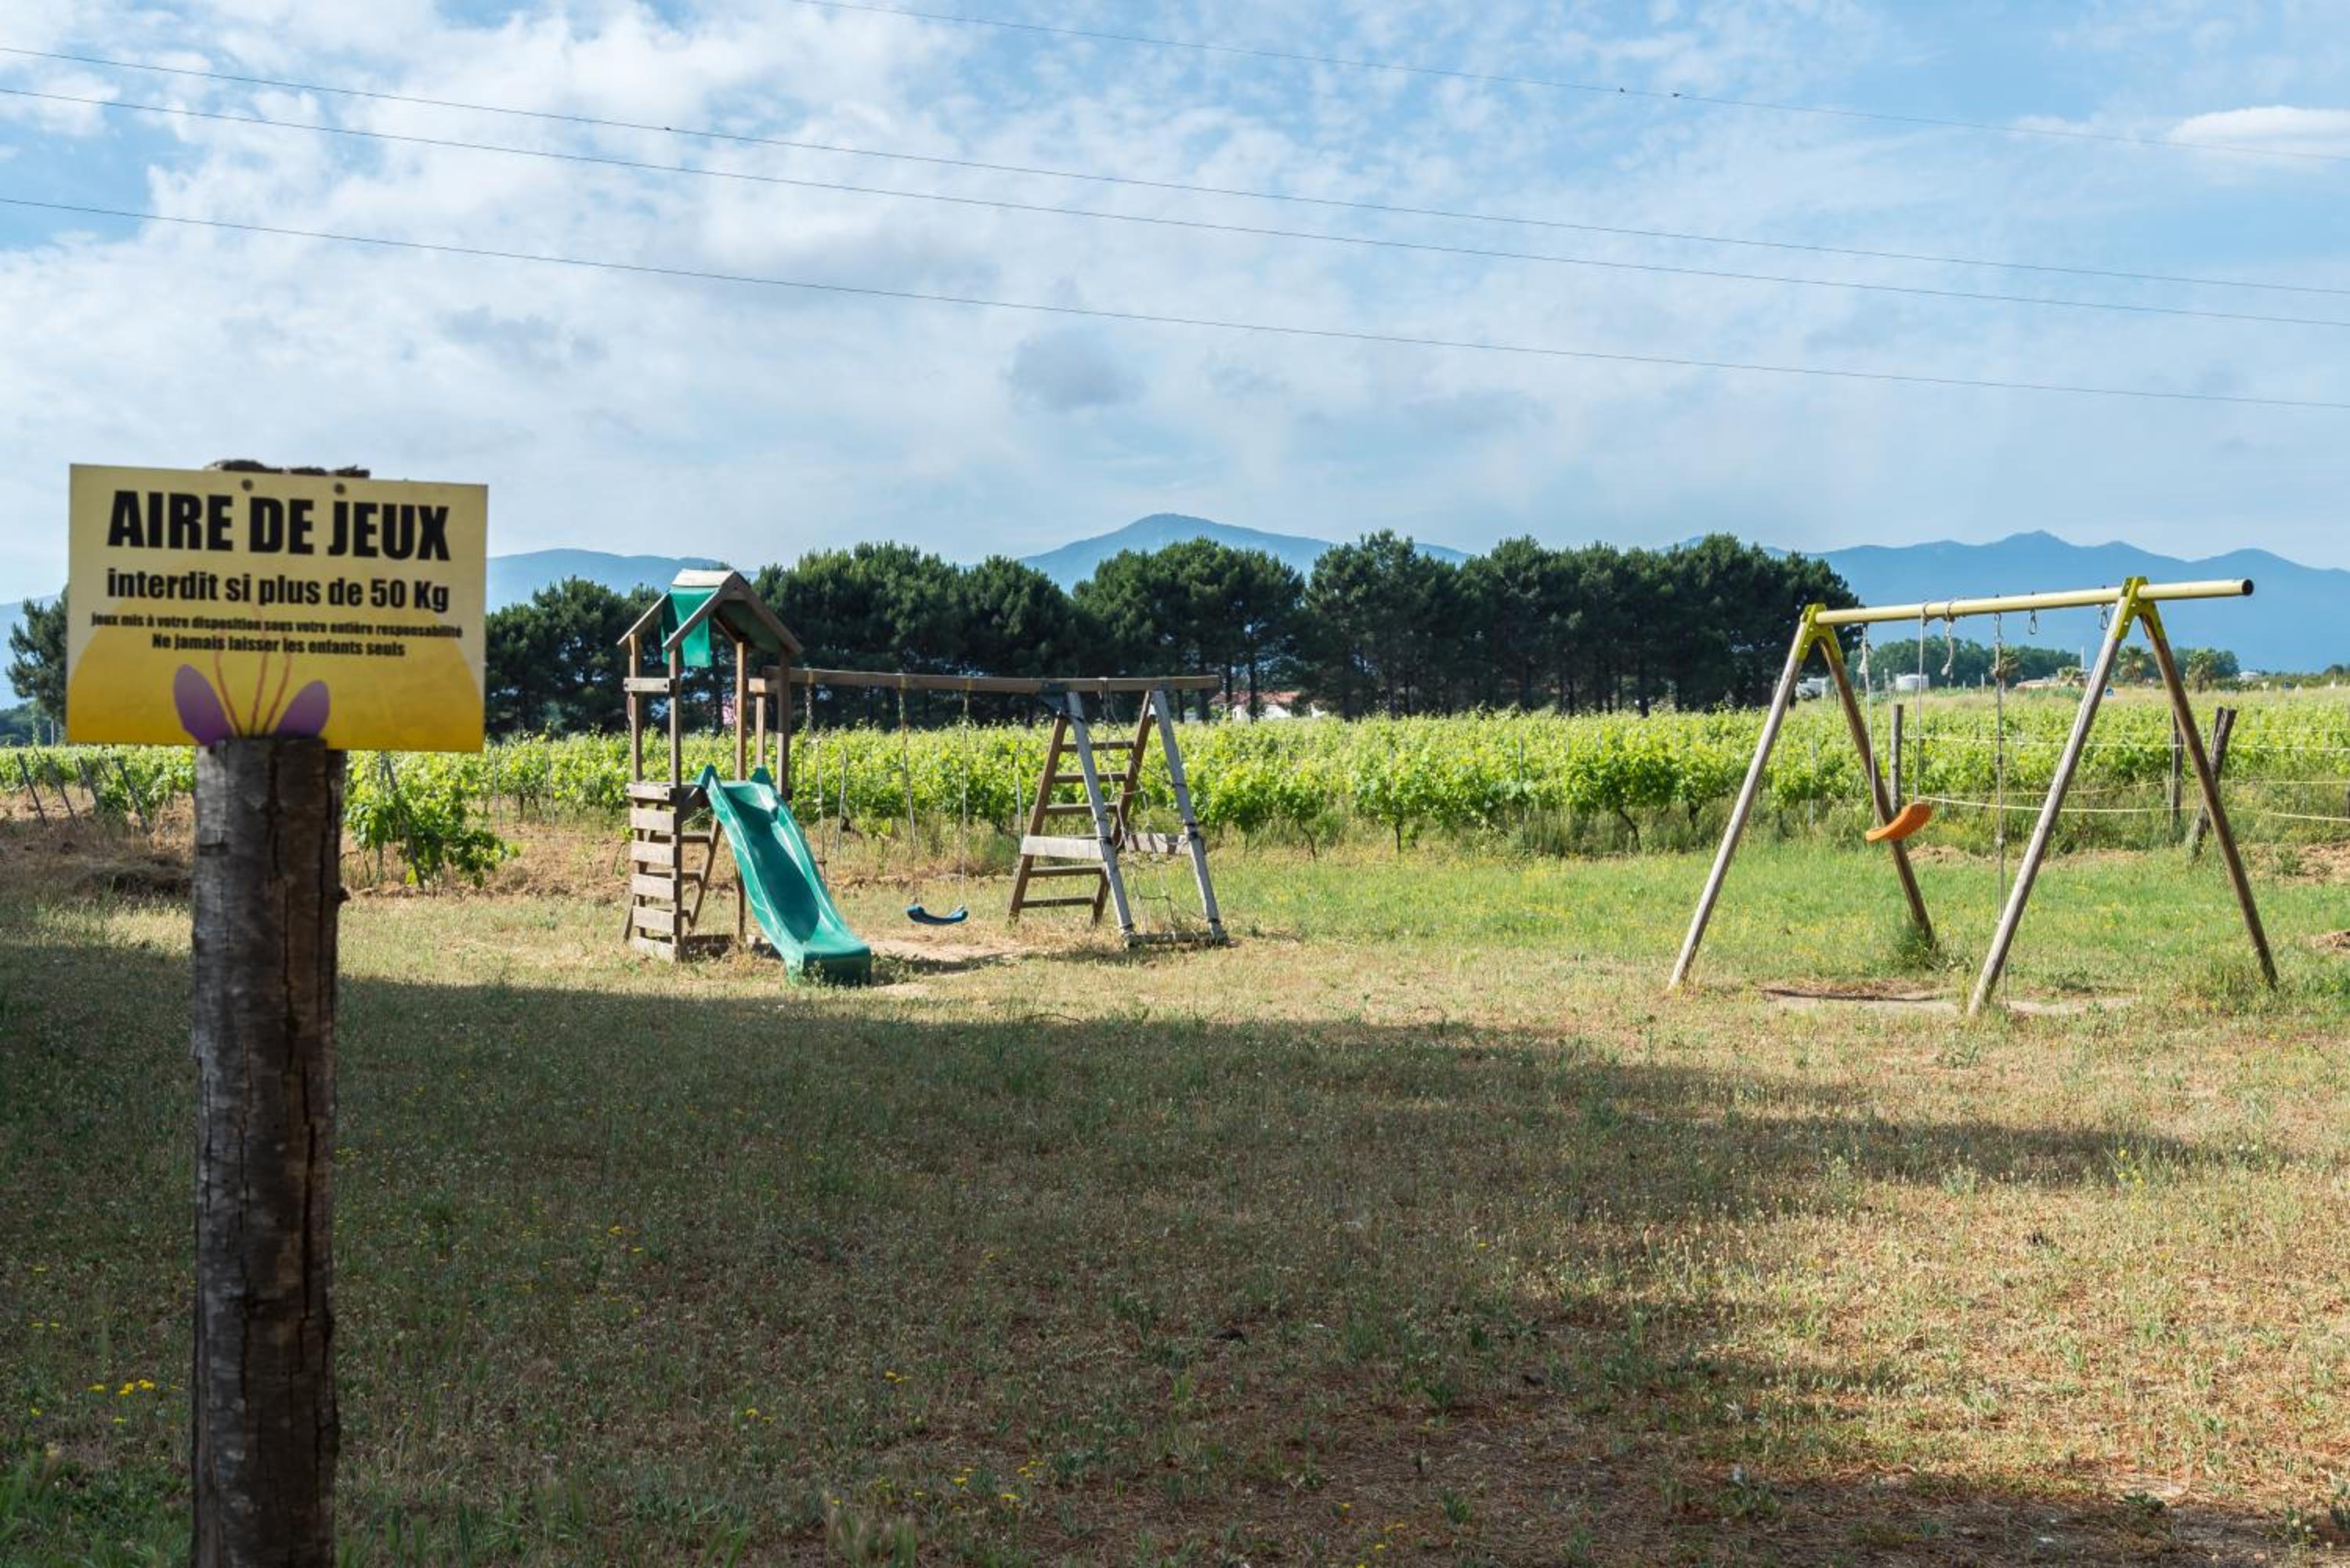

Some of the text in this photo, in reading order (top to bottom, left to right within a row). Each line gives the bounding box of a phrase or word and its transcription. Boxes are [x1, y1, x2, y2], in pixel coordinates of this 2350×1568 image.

[107, 490, 451, 562] AIRE DE JEUX
[107, 568, 450, 613] interdit si plus de 50 Kg
[121, 614, 144, 627] mis
[146, 613, 154, 627] à
[157, 616, 189, 628] votre
[192, 616, 262, 630] disposition
[264, 621, 293, 632] sous
[296, 621, 327, 633] votre
[331, 623, 373, 635] entière
[376, 624, 463, 638] responsabilité
[152, 633, 406, 656] Ne jamais laisser les enfants seuls
